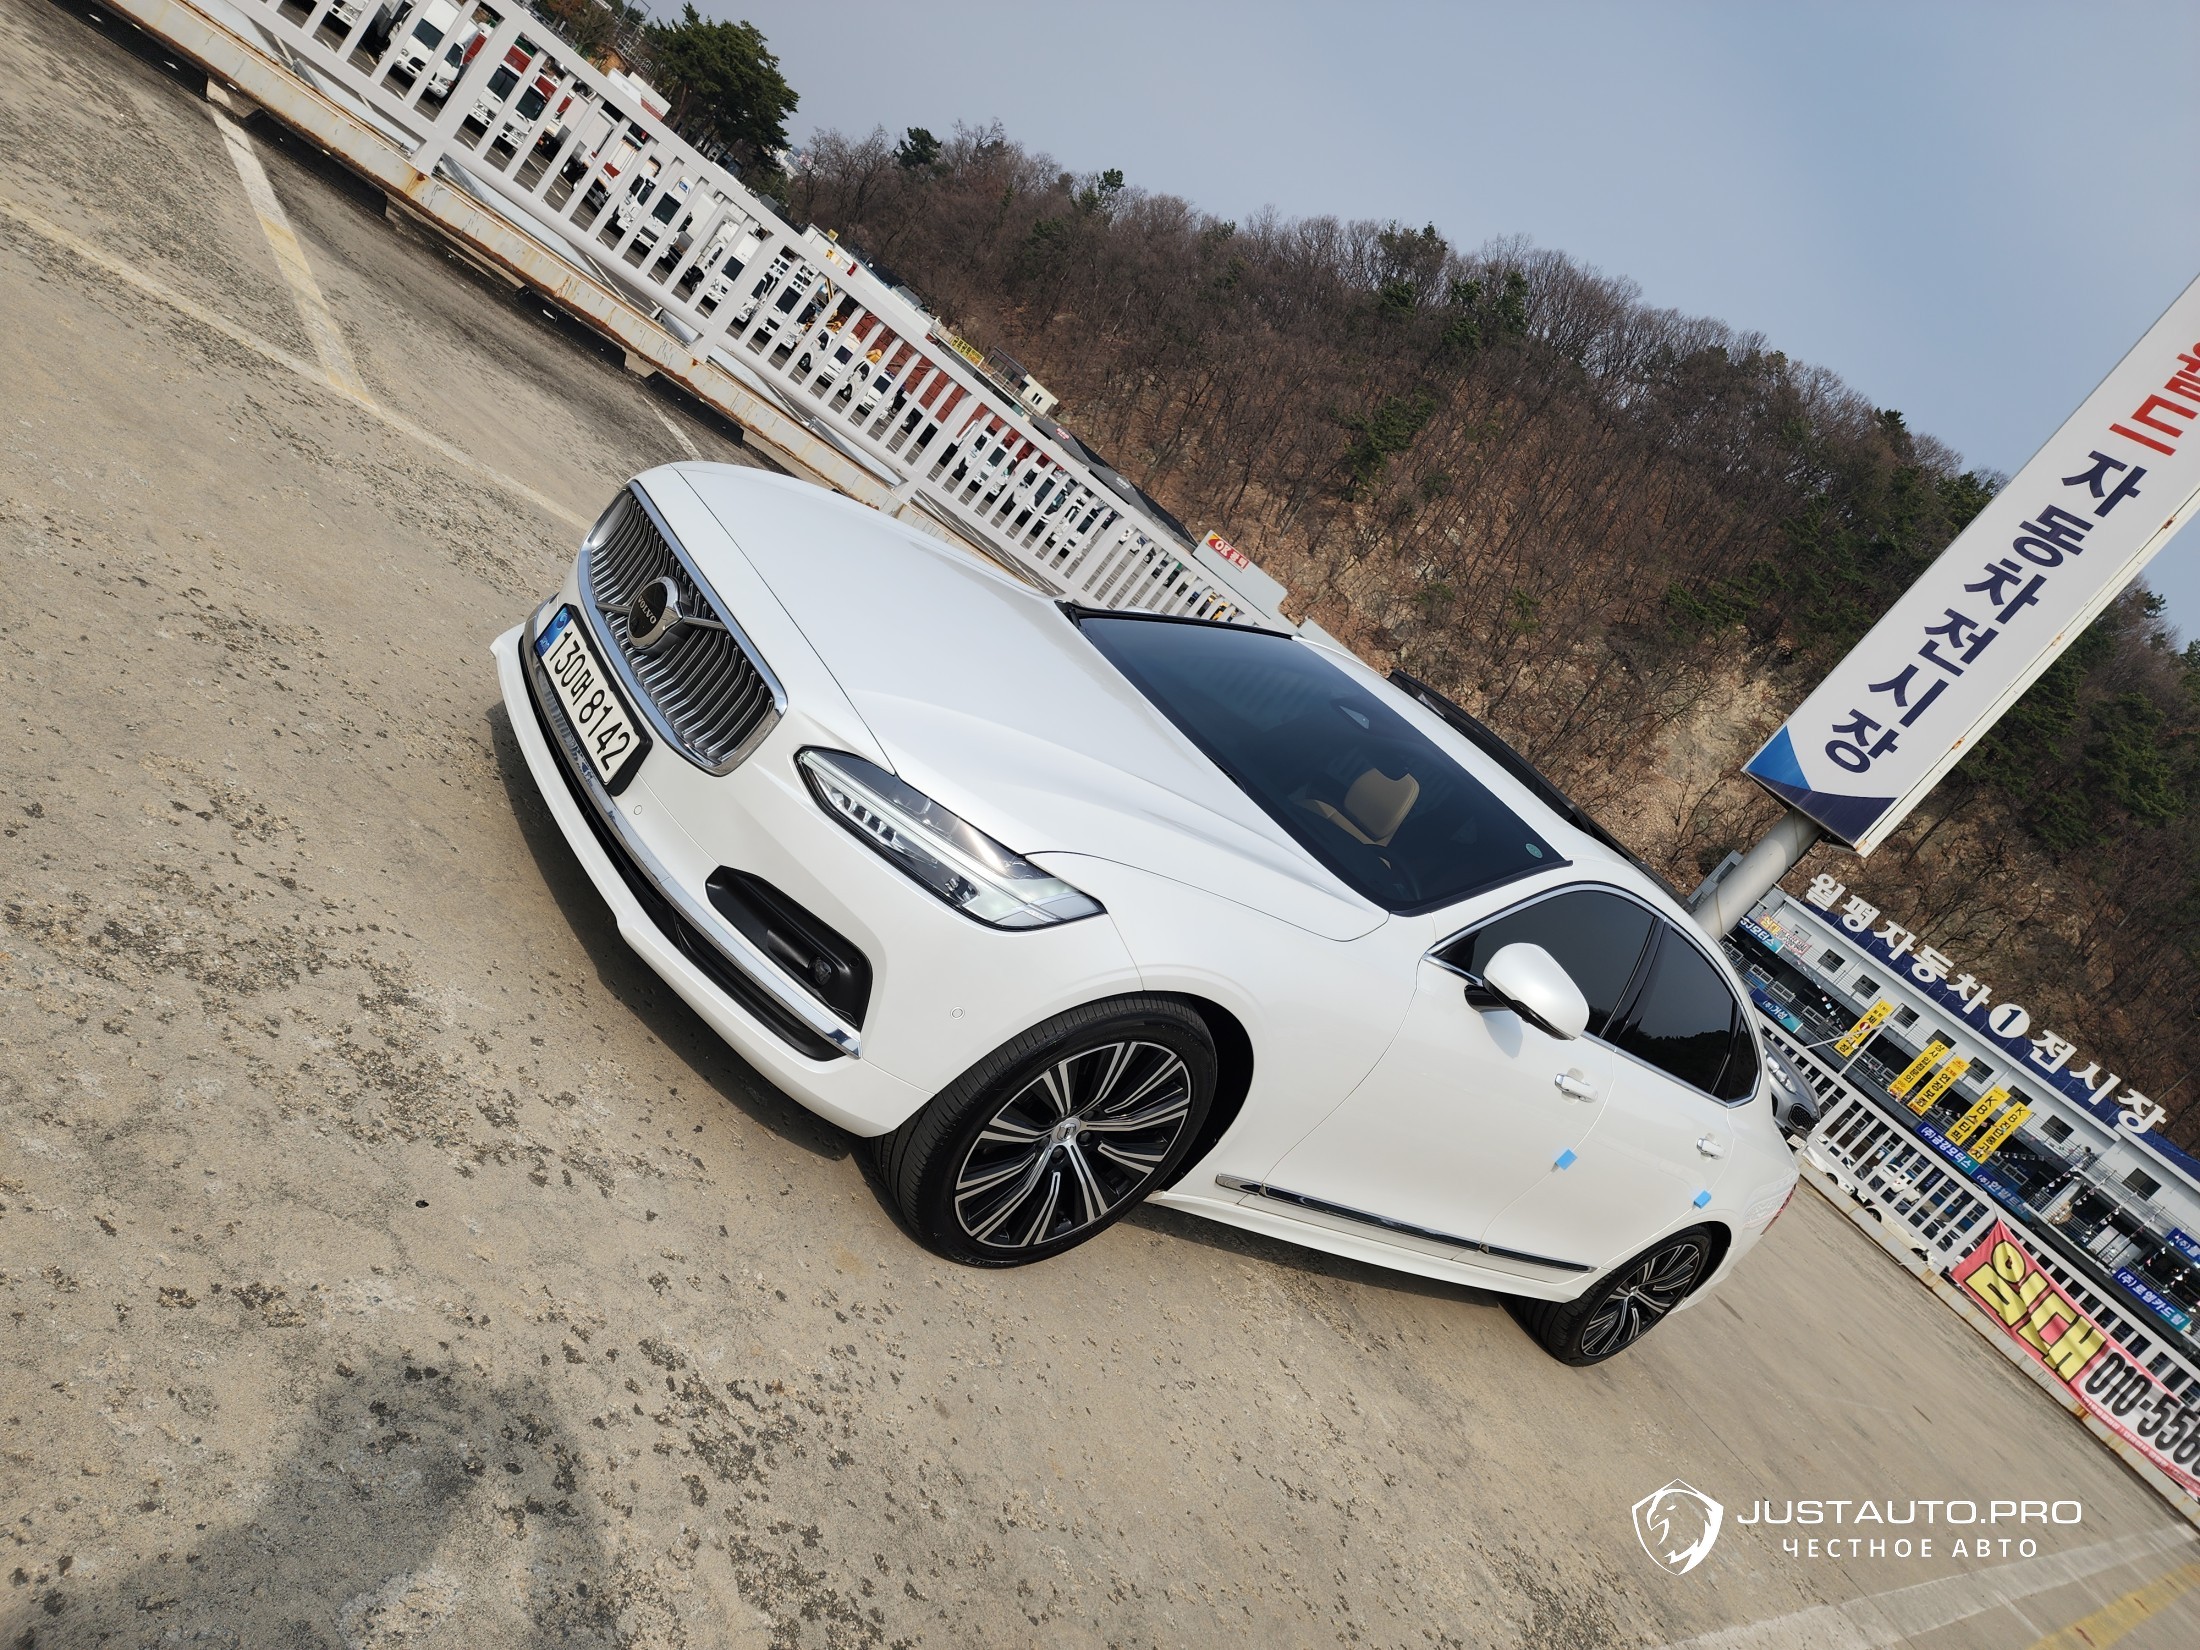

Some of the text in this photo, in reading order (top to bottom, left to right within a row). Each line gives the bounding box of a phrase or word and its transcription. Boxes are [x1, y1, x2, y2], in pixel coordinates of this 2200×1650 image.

[1215, 541, 1231, 556] OK
[638, 594, 657, 624] VOLVO
[1825, 450, 2147, 773] 자동차전시장
[579, 689, 630, 770] 8142
[1964, 1240, 2200, 1476] 임대 010-556
